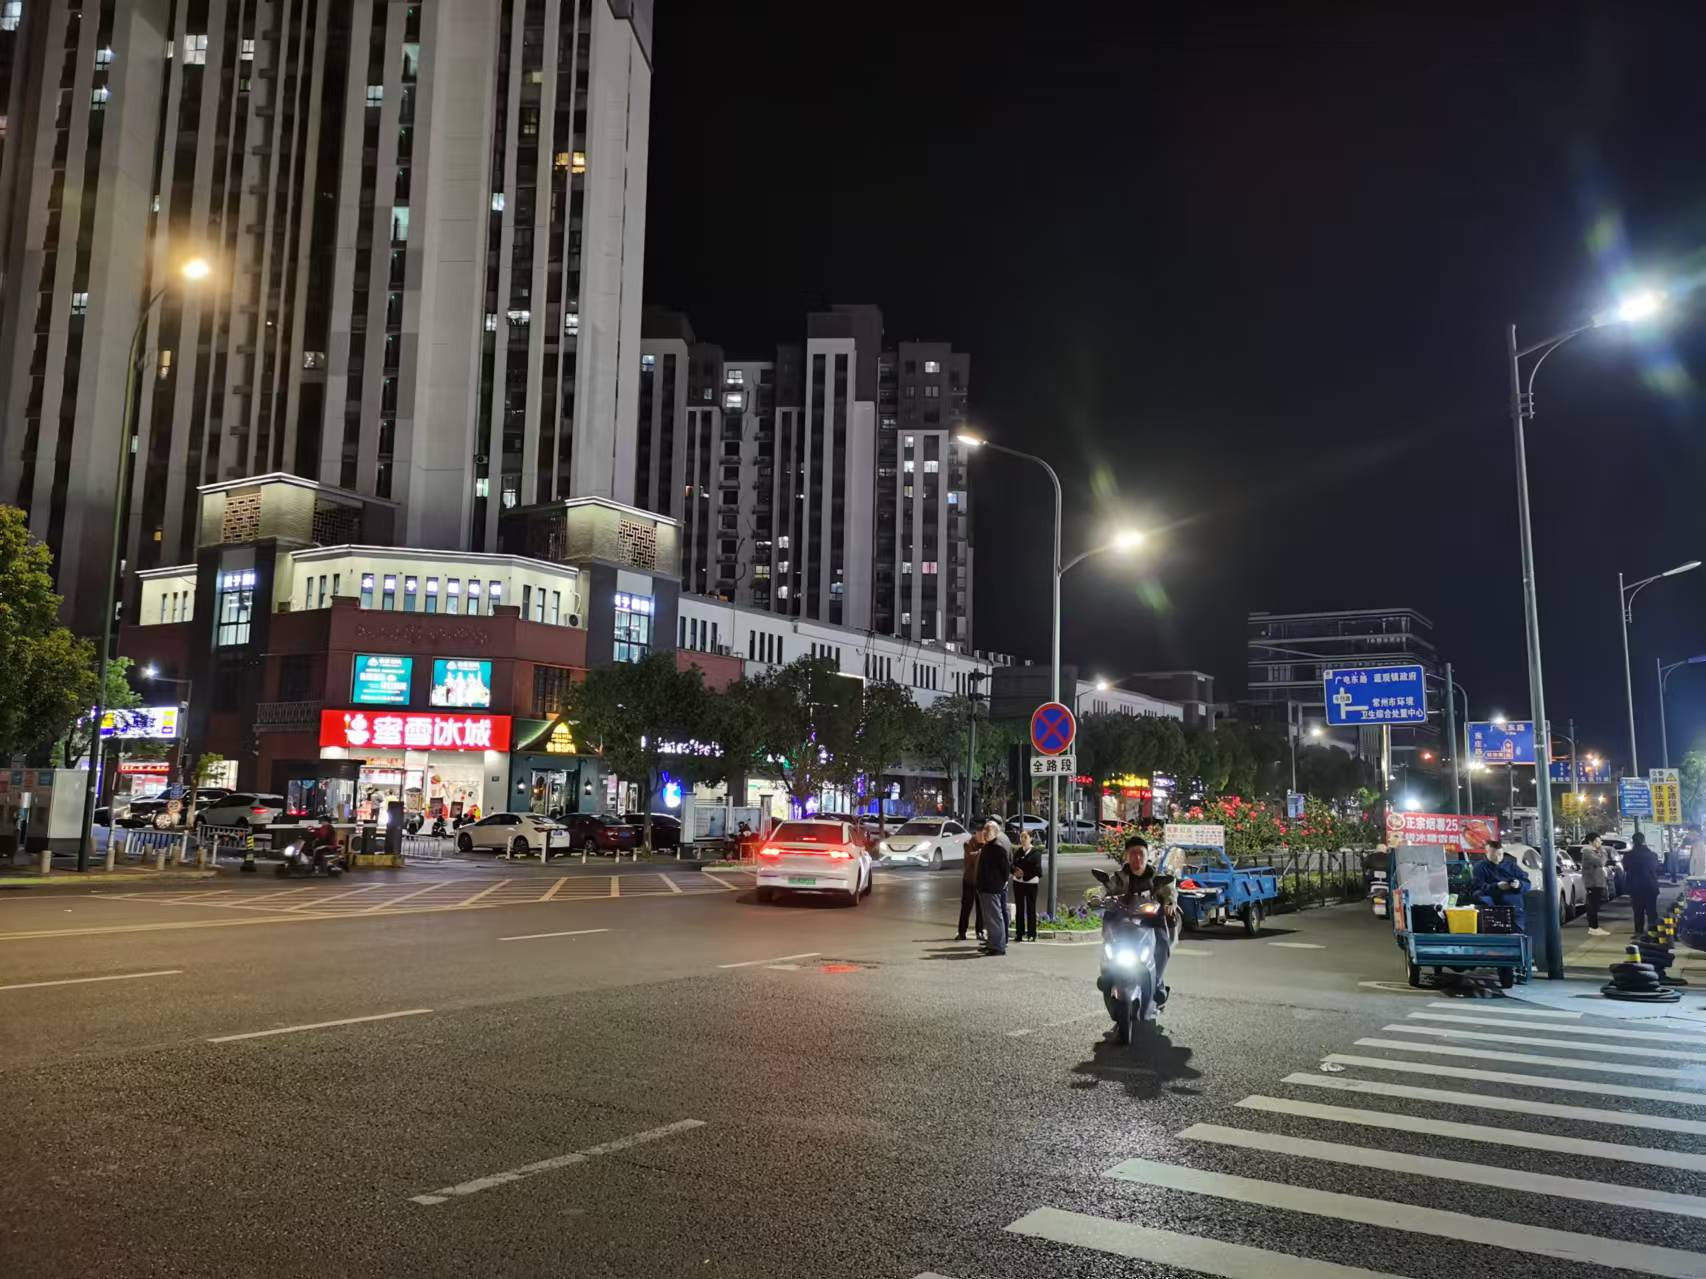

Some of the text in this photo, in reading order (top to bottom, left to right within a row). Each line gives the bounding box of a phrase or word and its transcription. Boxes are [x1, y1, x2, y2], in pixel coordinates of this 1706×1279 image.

[1372, 696, 1415, 707] 常州市环境
[1360, 708, 1424, 720] 卫生综合处置中心
[372, 716, 491, 747] 蜜雪冰城
[1033, 758, 1072, 773] 全路段
